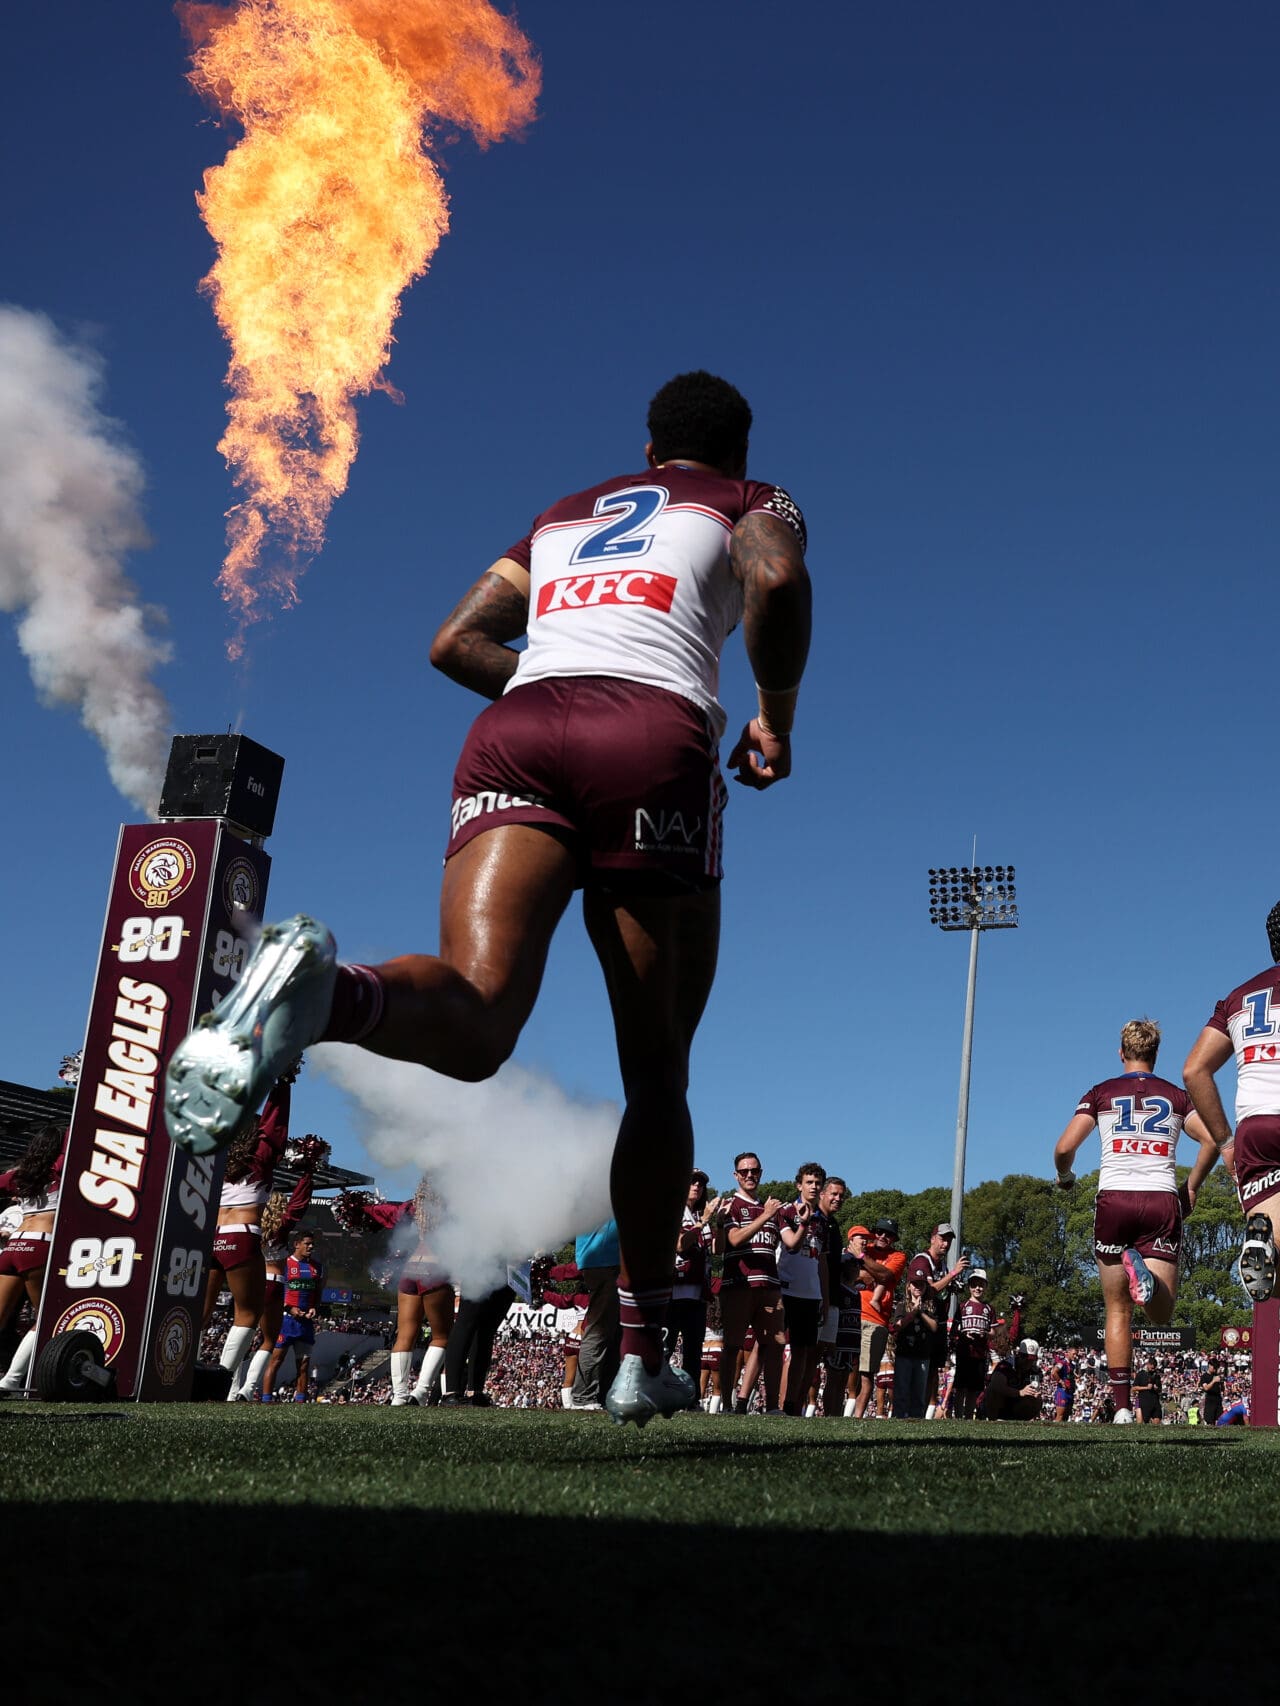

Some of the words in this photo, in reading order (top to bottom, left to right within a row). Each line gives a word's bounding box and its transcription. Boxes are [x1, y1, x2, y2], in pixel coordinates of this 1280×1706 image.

[569, 485, 669, 565] 2
[546, 572, 653, 611] KFC
[146, 890, 169, 907] 80
[118, 916, 184, 963] 80
[94, 976, 168, 1131] EAGLES
[1111, 1095, 1173, 1135] 12
[1120, 1139, 1163, 1155] KFC
[79, 1128, 147, 1218] SEA
[311, 1198, 333, 1206] WING
[65, 1237, 136, 1289] 80
[166, 1248, 203, 1297] 80
